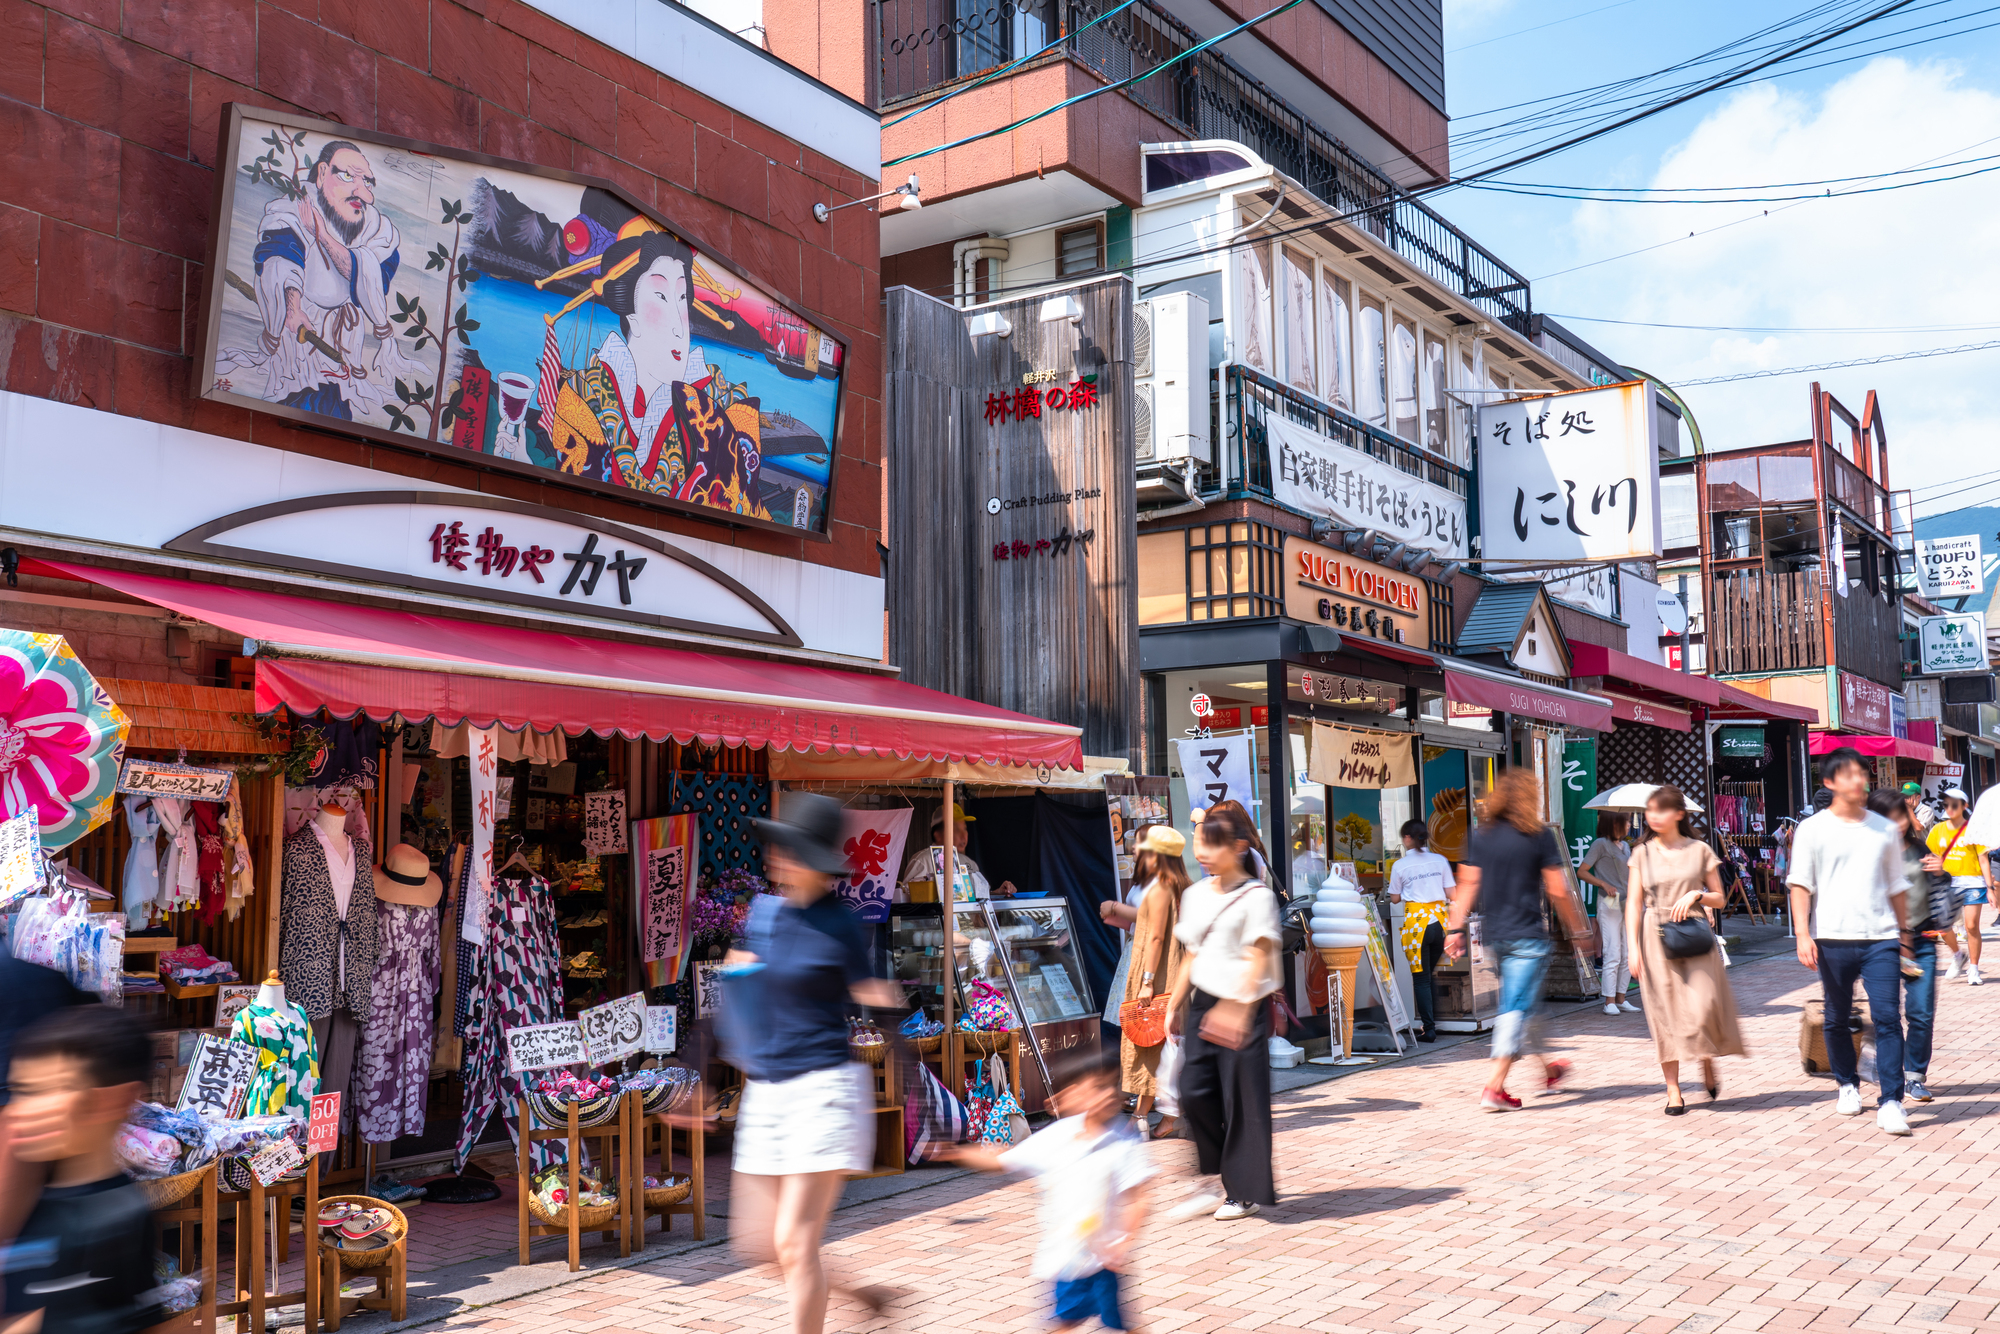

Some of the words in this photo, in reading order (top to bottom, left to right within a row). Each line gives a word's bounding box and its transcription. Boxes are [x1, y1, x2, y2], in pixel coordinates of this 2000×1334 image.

[1022, 368, 1057, 385] 軽井沢
[983, 375, 1098, 426] 林檎の森
[1492, 410, 1596, 445] そば処
[1003, 496, 1028, 510] Craft
[1030, 492, 1072, 507] Pudding
[1074, 488, 1101, 501] Plant
[1513, 477, 1638, 543] にし川
[1921, 550, 1976, 565] TOUFU
[1931, 541, 1972, 551] handicraft
[1299, 550, 1343, 588] SUGI
[1346, 566, 1420, 611] YOHOEN
[1927, 565, 1973, 580] とうふ
[1928, 579, 1970, 588] KARUIZAWA
[1509, 693, 1529, 710] SUGI
[1532, 697, 1567, 718] YOHOEN
[1722, 738, 1761, 748] Stream
[608, 795, 624, 848] わんちゃん
[652, 853, 680, 896] 夏
[511, 1025, 583, 1048] のぞいてごらん
[232, 1052, 253, 1084] 子供
[310, 1122, 338, 1140] OFF
